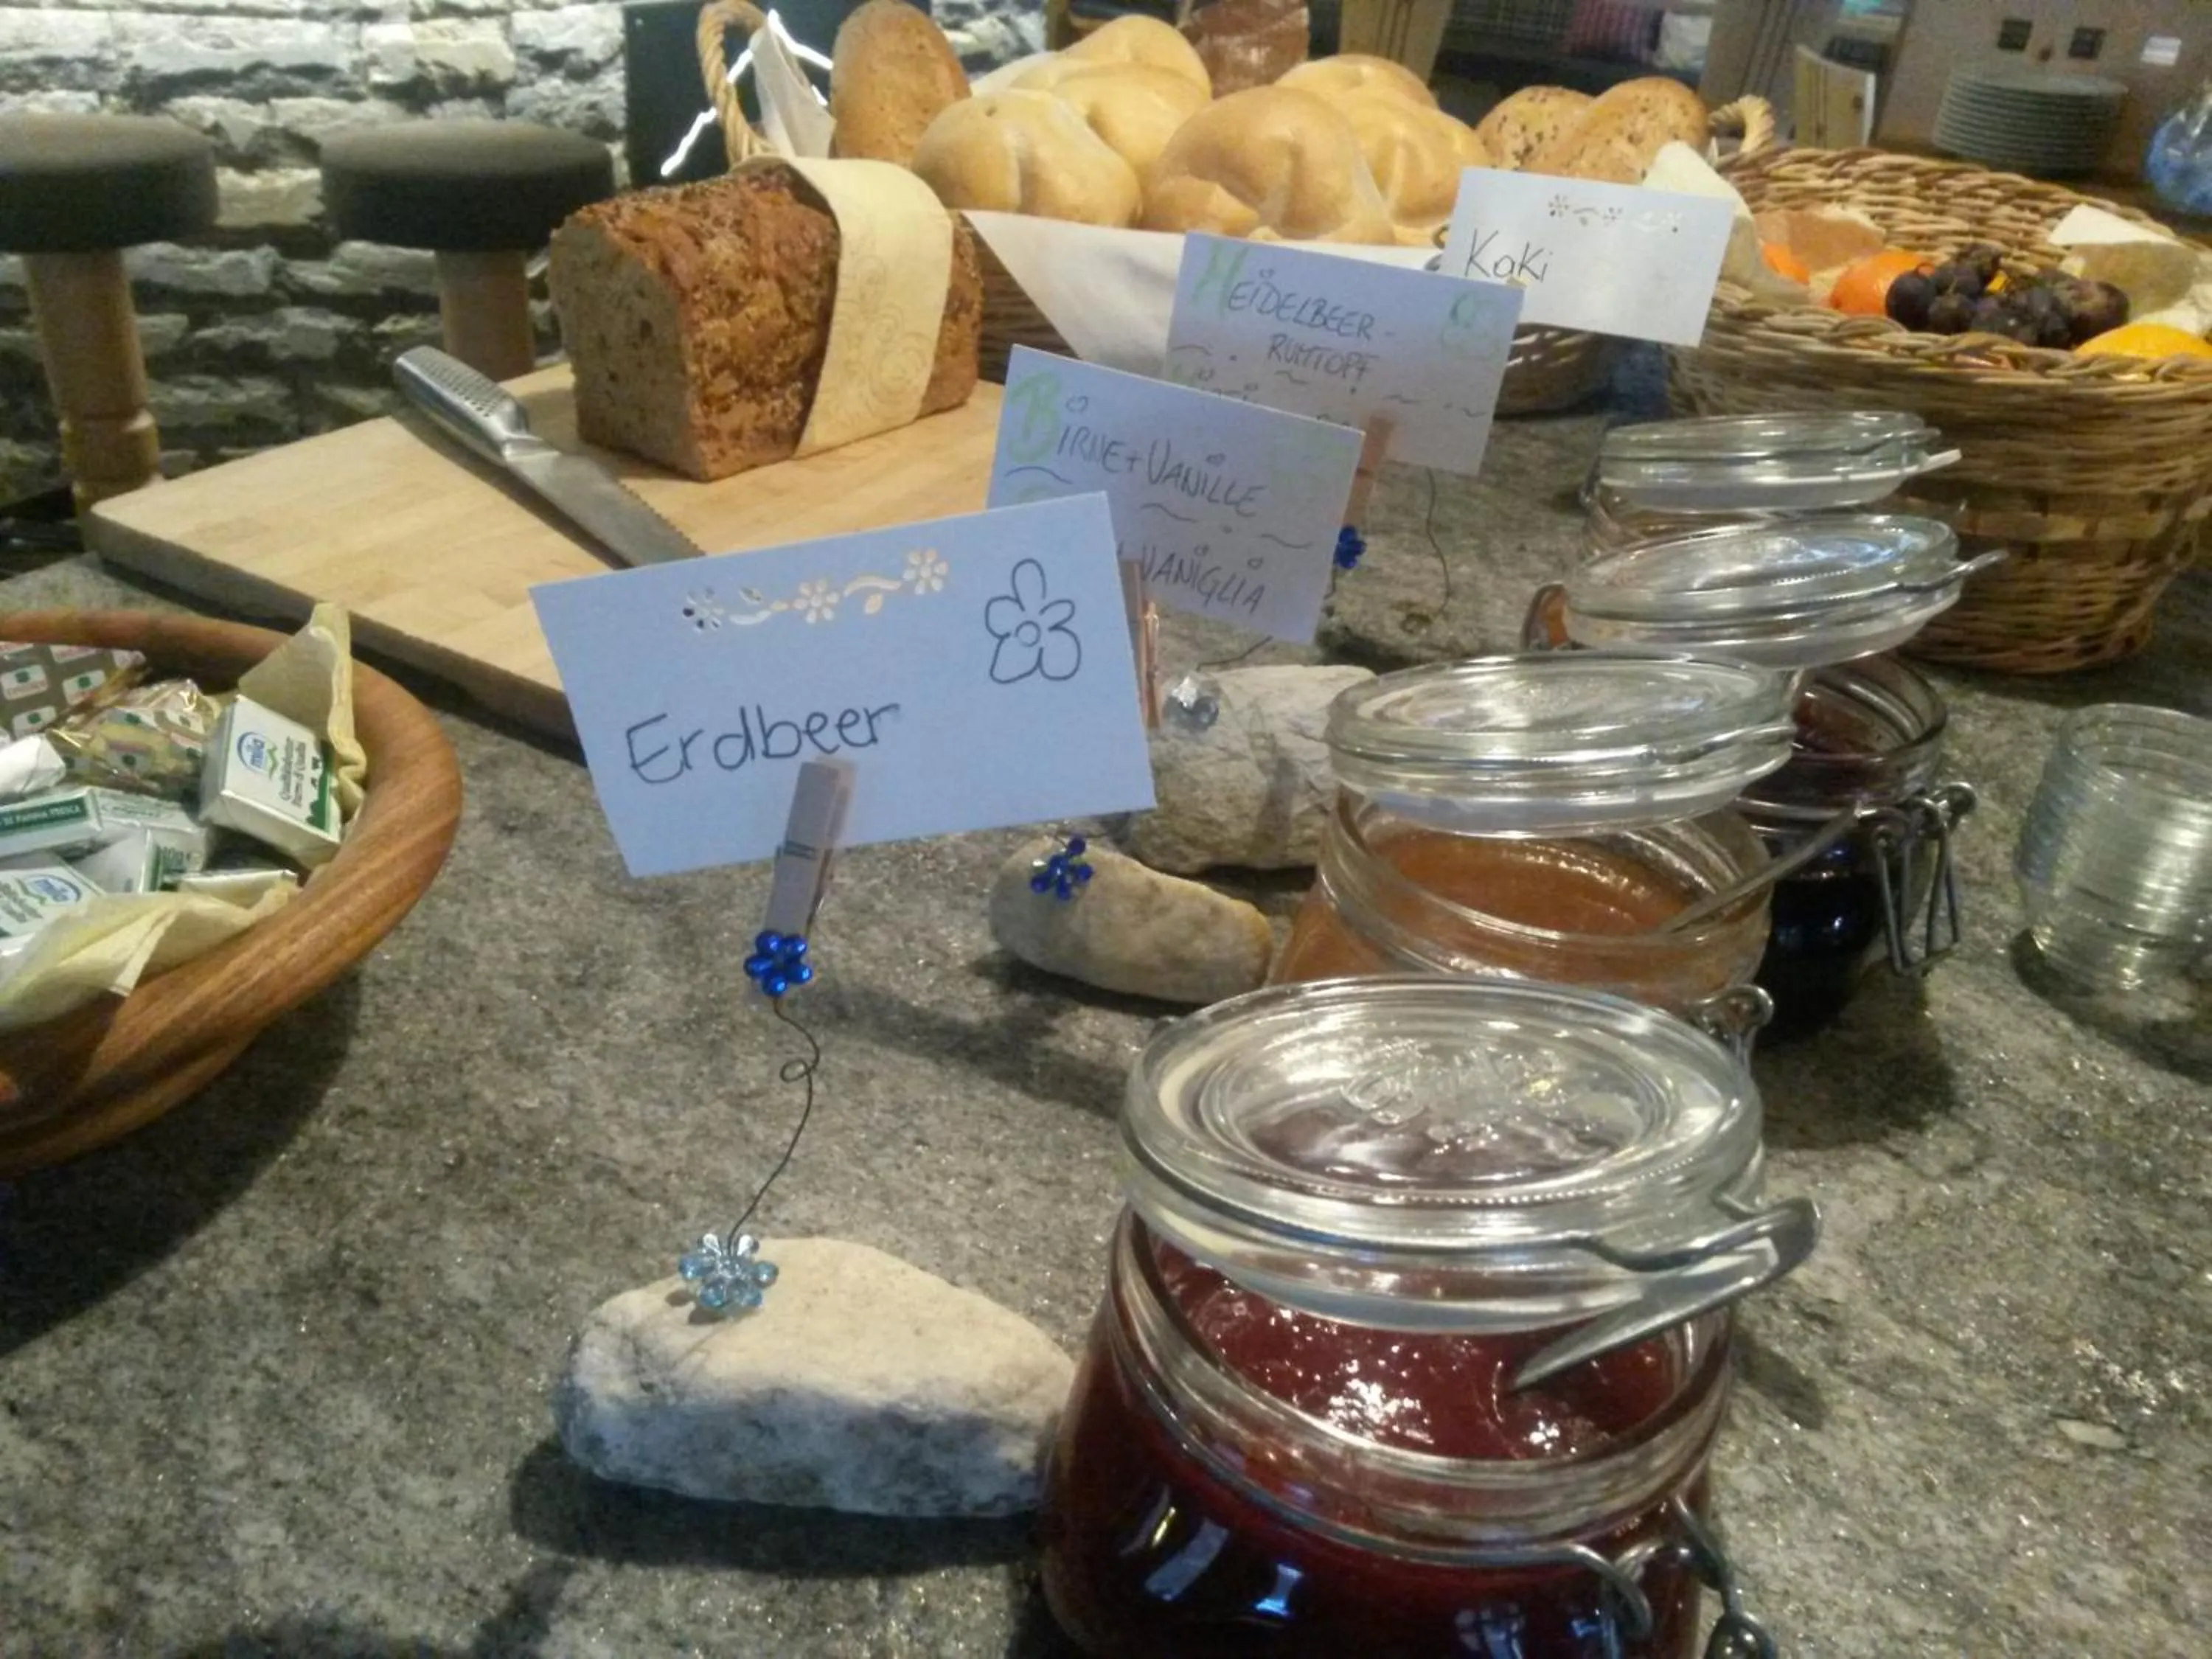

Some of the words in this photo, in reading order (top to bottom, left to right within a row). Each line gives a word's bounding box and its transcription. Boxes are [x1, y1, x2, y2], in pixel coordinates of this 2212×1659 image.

[1267, 333, 1382, 380] RUMTOPF
[1140, 543, 1266, 615] VANIGLIA
[626, 703, 900, 784] Erdbeer
